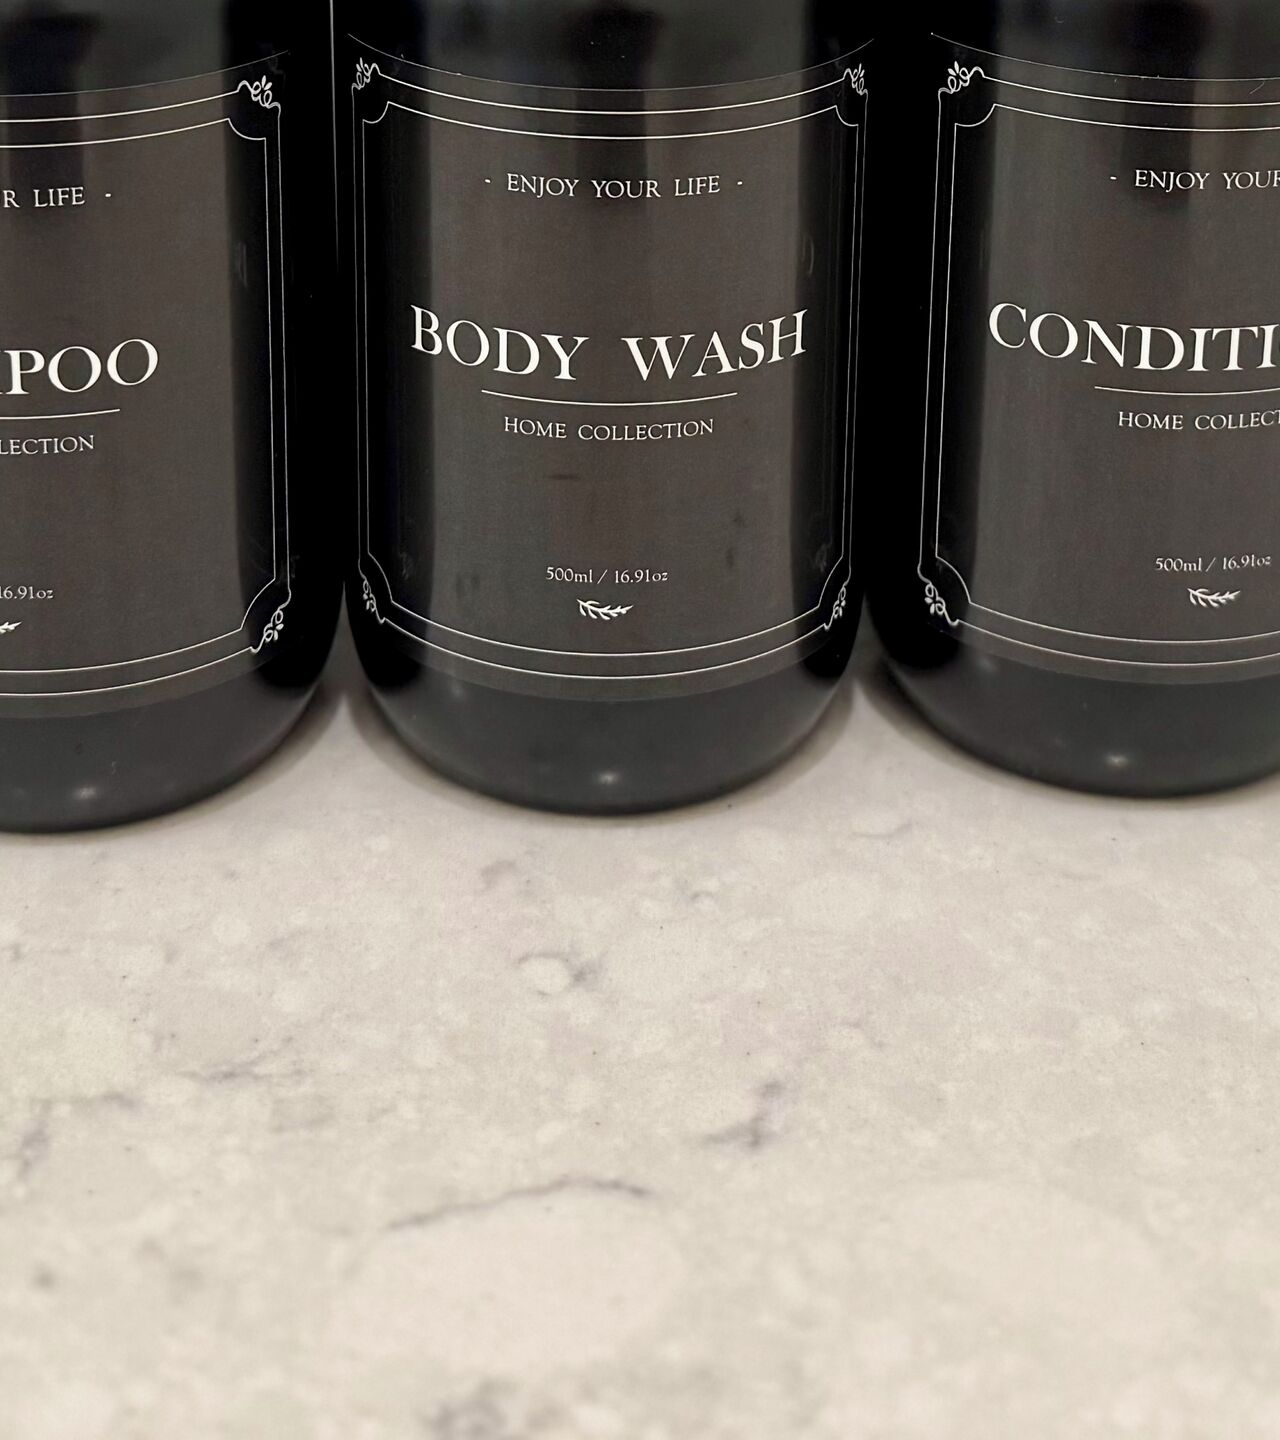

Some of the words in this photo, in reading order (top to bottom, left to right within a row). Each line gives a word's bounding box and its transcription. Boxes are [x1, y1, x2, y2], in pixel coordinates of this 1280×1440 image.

[507, 172, 580, 199] ENJOY
[590, 179, 662, 199] YOUR
[674, 175, 721, 197] LIFE
[1134, 169, 1211, 193] ENJOY
[32, 186, 86, 208] LIFE
[410, 304, 590, 381] BODY
[620, 308, 808, 382] WASH
[504, 416, 567, 439] HOME
[577, 418, 714, 441] COLLECTION
[1118, 411, 1184, 430] HOME
[1155, 557, 1202, 572] 500ml
[1222, 554, 1271, 570] 16.91oz
[546, 566, 593, 583] 500ml
[615, 568, 668, 584] 16.91oz
